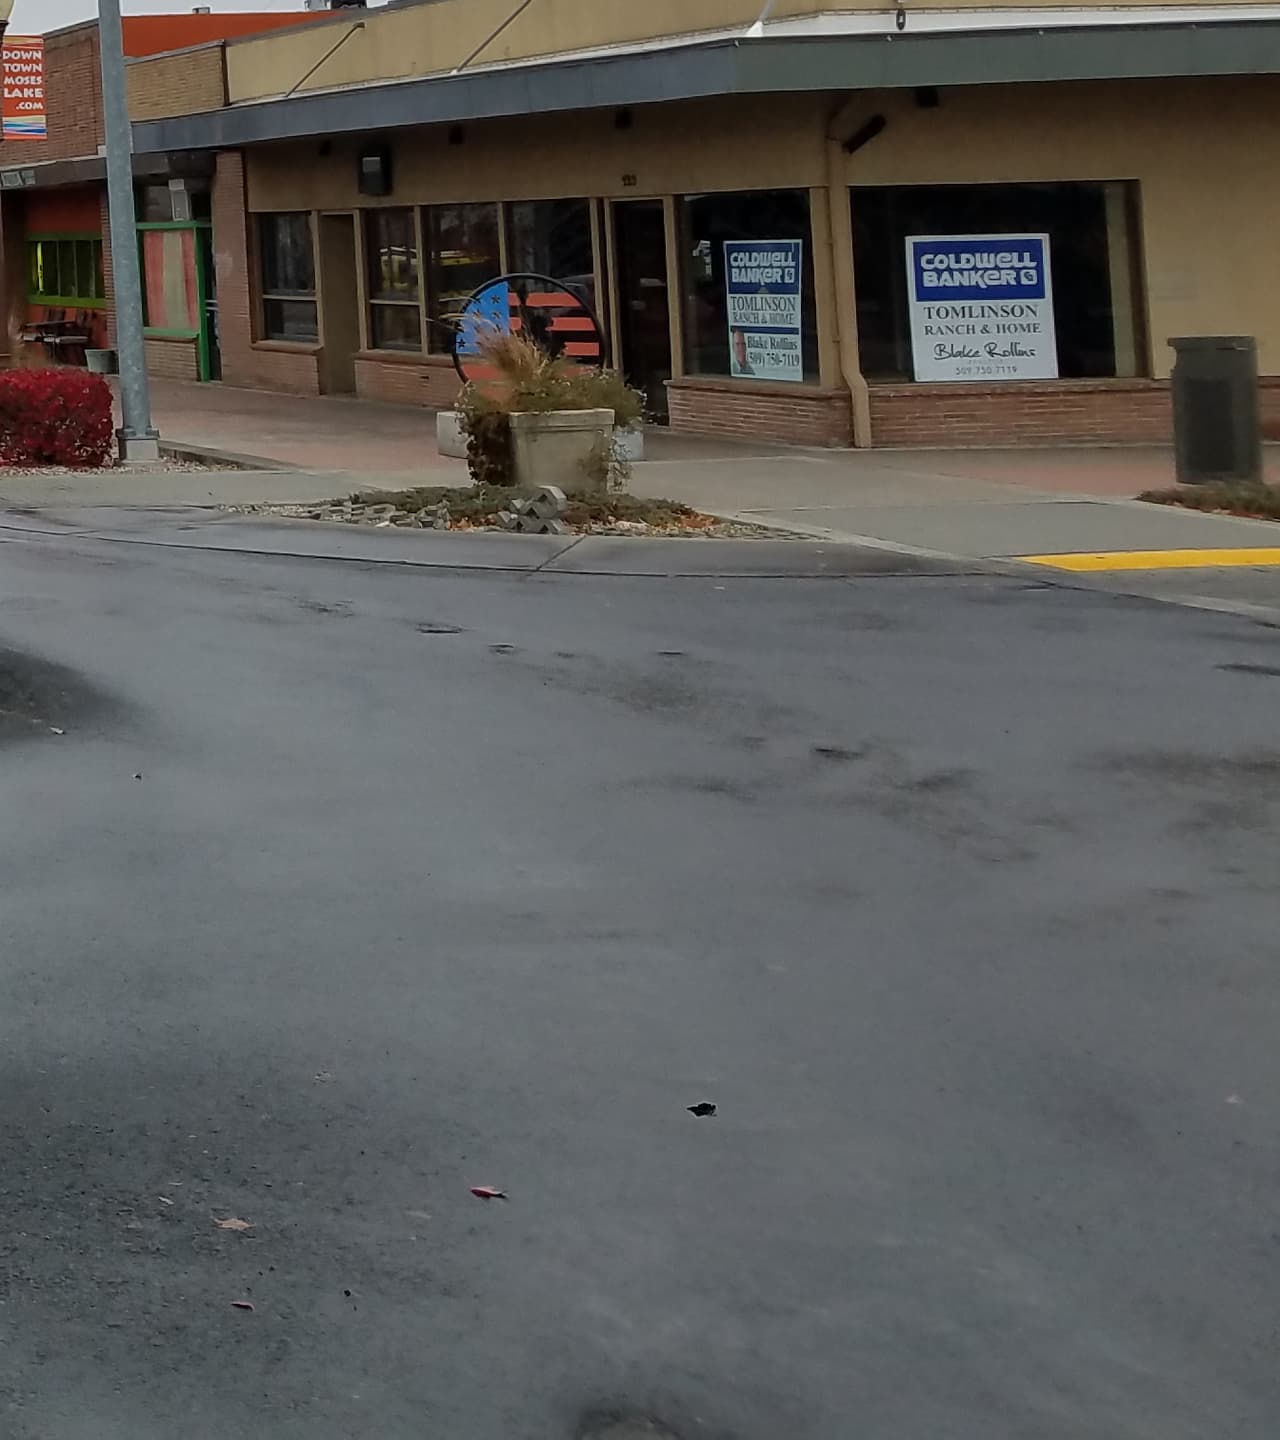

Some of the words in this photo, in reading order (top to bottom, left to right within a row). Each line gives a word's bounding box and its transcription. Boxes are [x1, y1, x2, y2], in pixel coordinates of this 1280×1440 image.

[2, 50, 42, 60] DOWN
[3, 63, 42, 73] TOWN
[3, 76, 43, 85] MOSES
[3, 88, 43, 98] LAKE
[16, 101, 44, 110] .COM
[730, 251, 796, 267] COLDWELL
[920, 252, 1038, 270] COLDWELL
[731, 268, 783, 286] BANKER
[923, 269, 1017, 288] BANKER
[730, 296, 796, 312] TOMLINSON
[924, 304, 1039, 319] TOMLINSON
[924, 324, 976, 335] RANCH
[980, 324, 991, 334] &
[996, 322, 1042, 334] HOME
[933, 342, 981, 360] Blake
